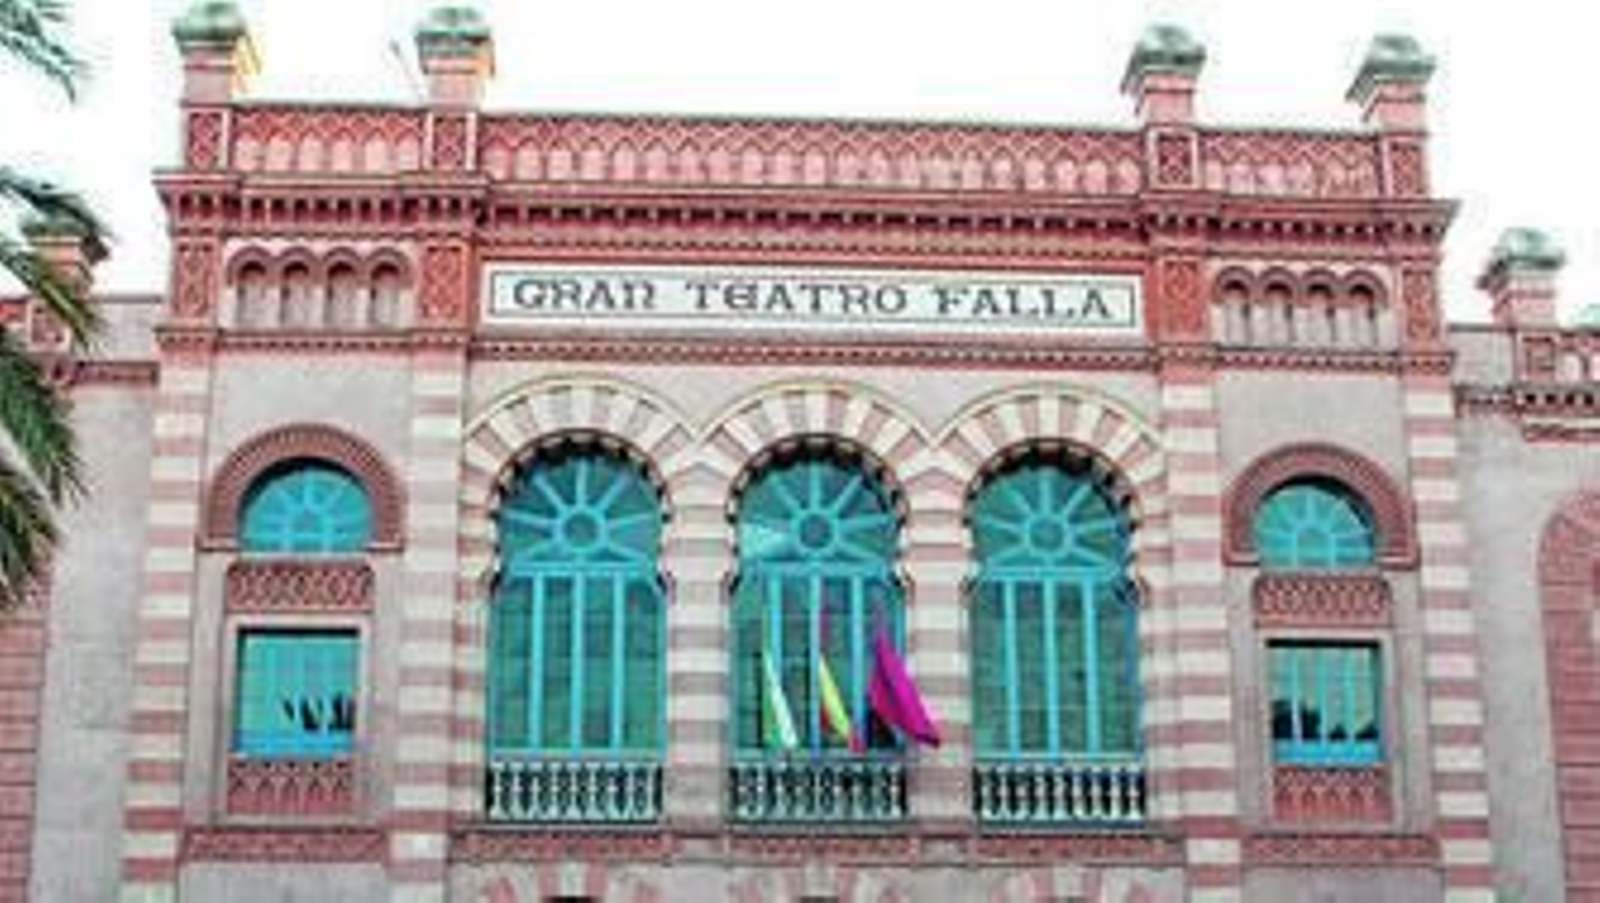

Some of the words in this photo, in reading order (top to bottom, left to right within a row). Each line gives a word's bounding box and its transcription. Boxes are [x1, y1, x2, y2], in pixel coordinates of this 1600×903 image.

[512, 279, 657, 309] GRAN
[685, 282, 907, 314] TEATRO
[933, 287, 1112, 319] FALLA
